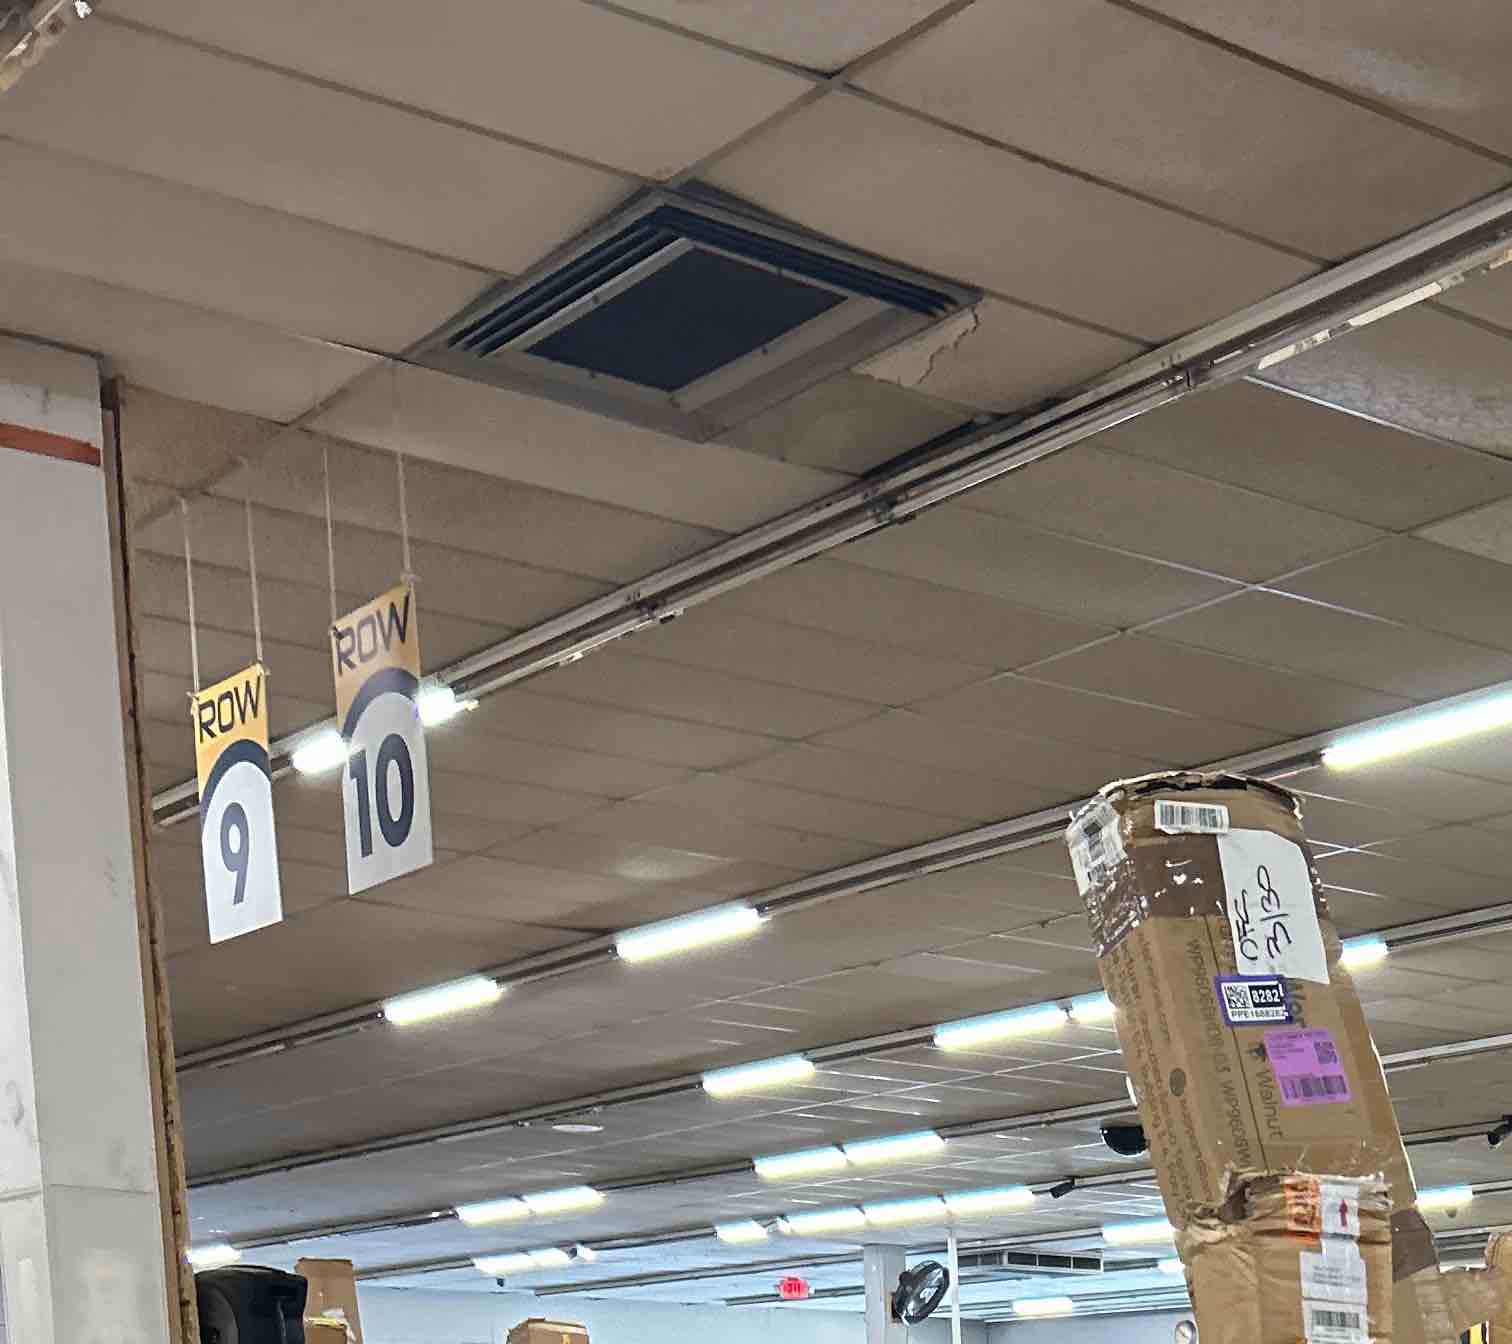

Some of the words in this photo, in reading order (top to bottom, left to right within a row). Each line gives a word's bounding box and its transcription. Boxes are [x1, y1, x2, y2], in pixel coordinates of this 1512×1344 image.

[335, 595, 411, 676] ROW
[199, 676, 262, 743] ROW
[350, 733, 415, 858] 10
[219, 802, 251, 906] 9
[1250, 988, 1281, 1004] 8282
[1256, 1069, 1284, 1139] Walnut
